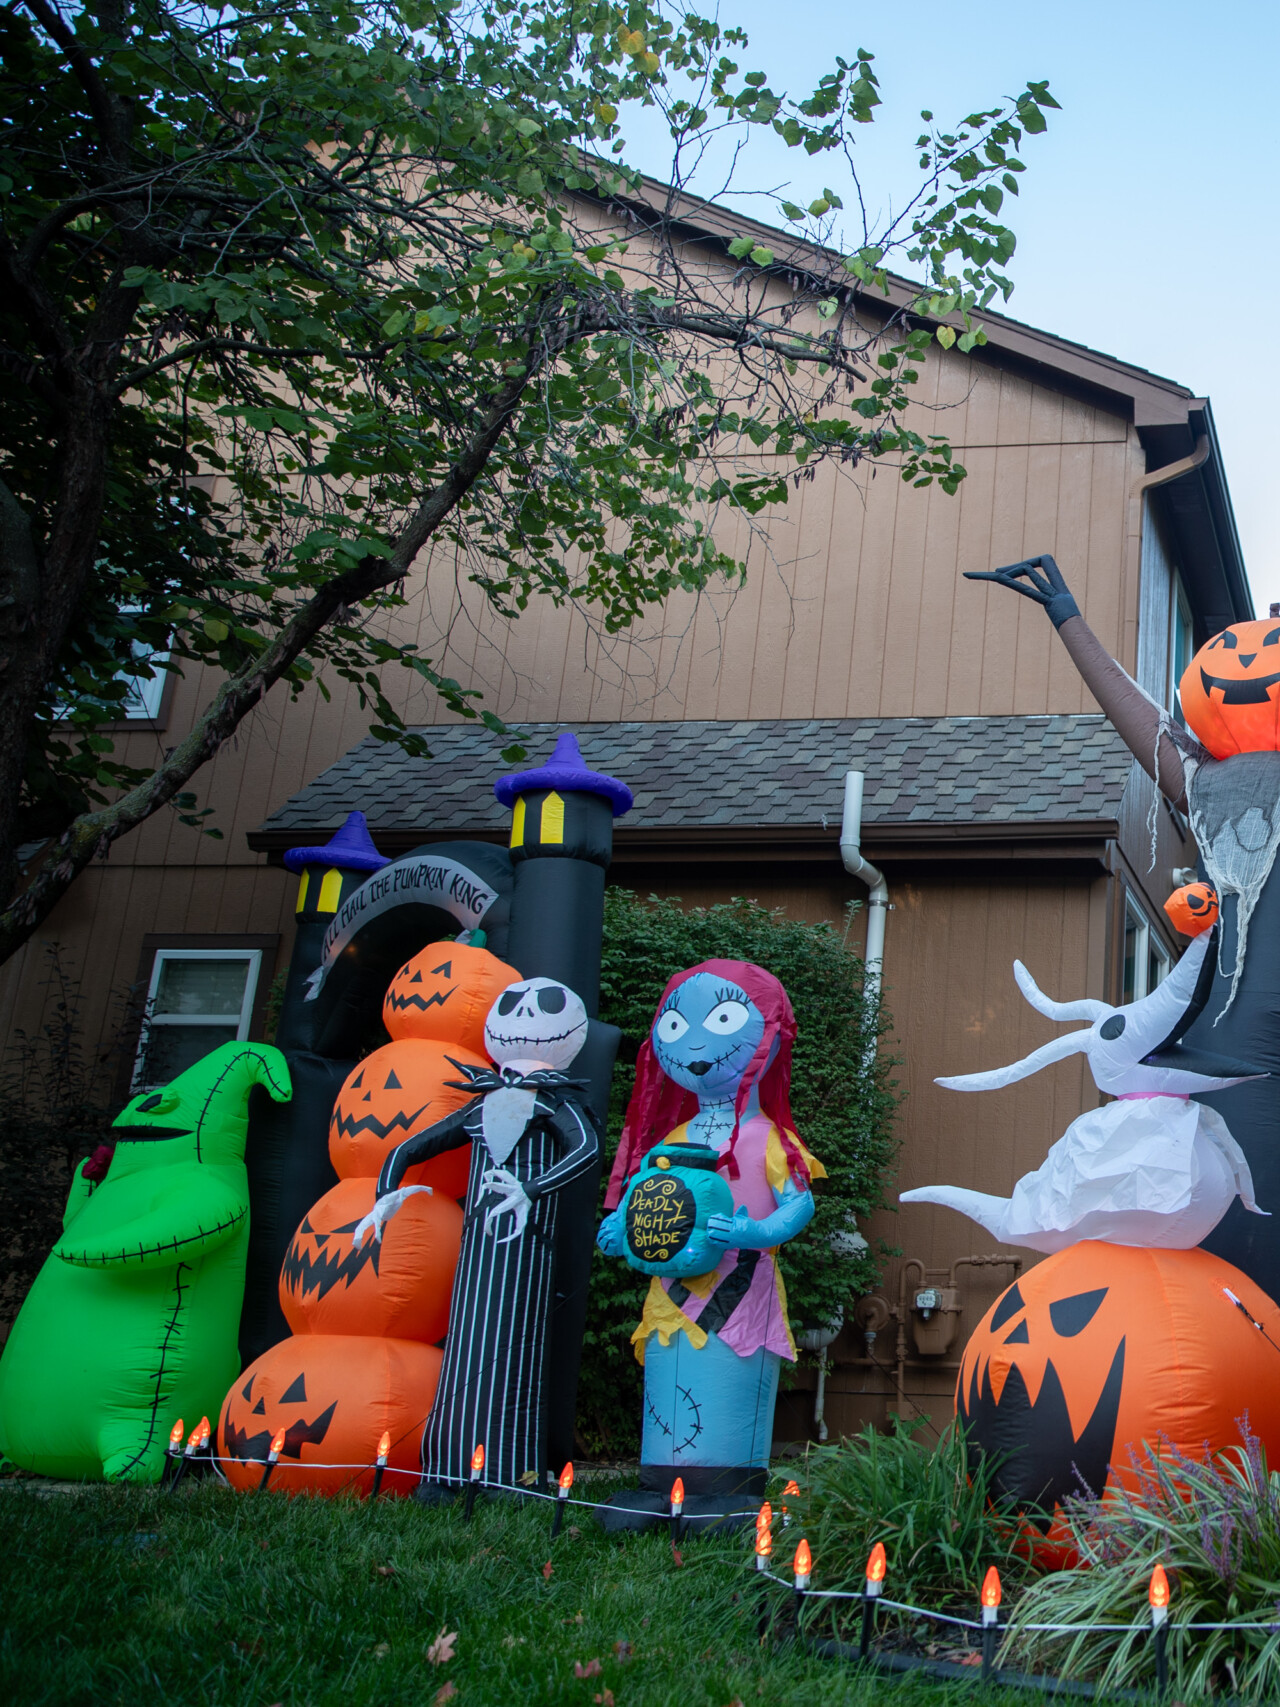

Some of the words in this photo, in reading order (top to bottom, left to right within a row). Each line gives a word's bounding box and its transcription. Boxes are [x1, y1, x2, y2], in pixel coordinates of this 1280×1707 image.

[340, 890, 367, 928] HAIL
[369, 874, 391, 903] THE
[394, 861, 452, 893] PUMPKIN
[449, 873, 489, 915] KING
[629, 1189, 685, 1223] DEADLY
[634, 1227, 680, 1247] SHADE
